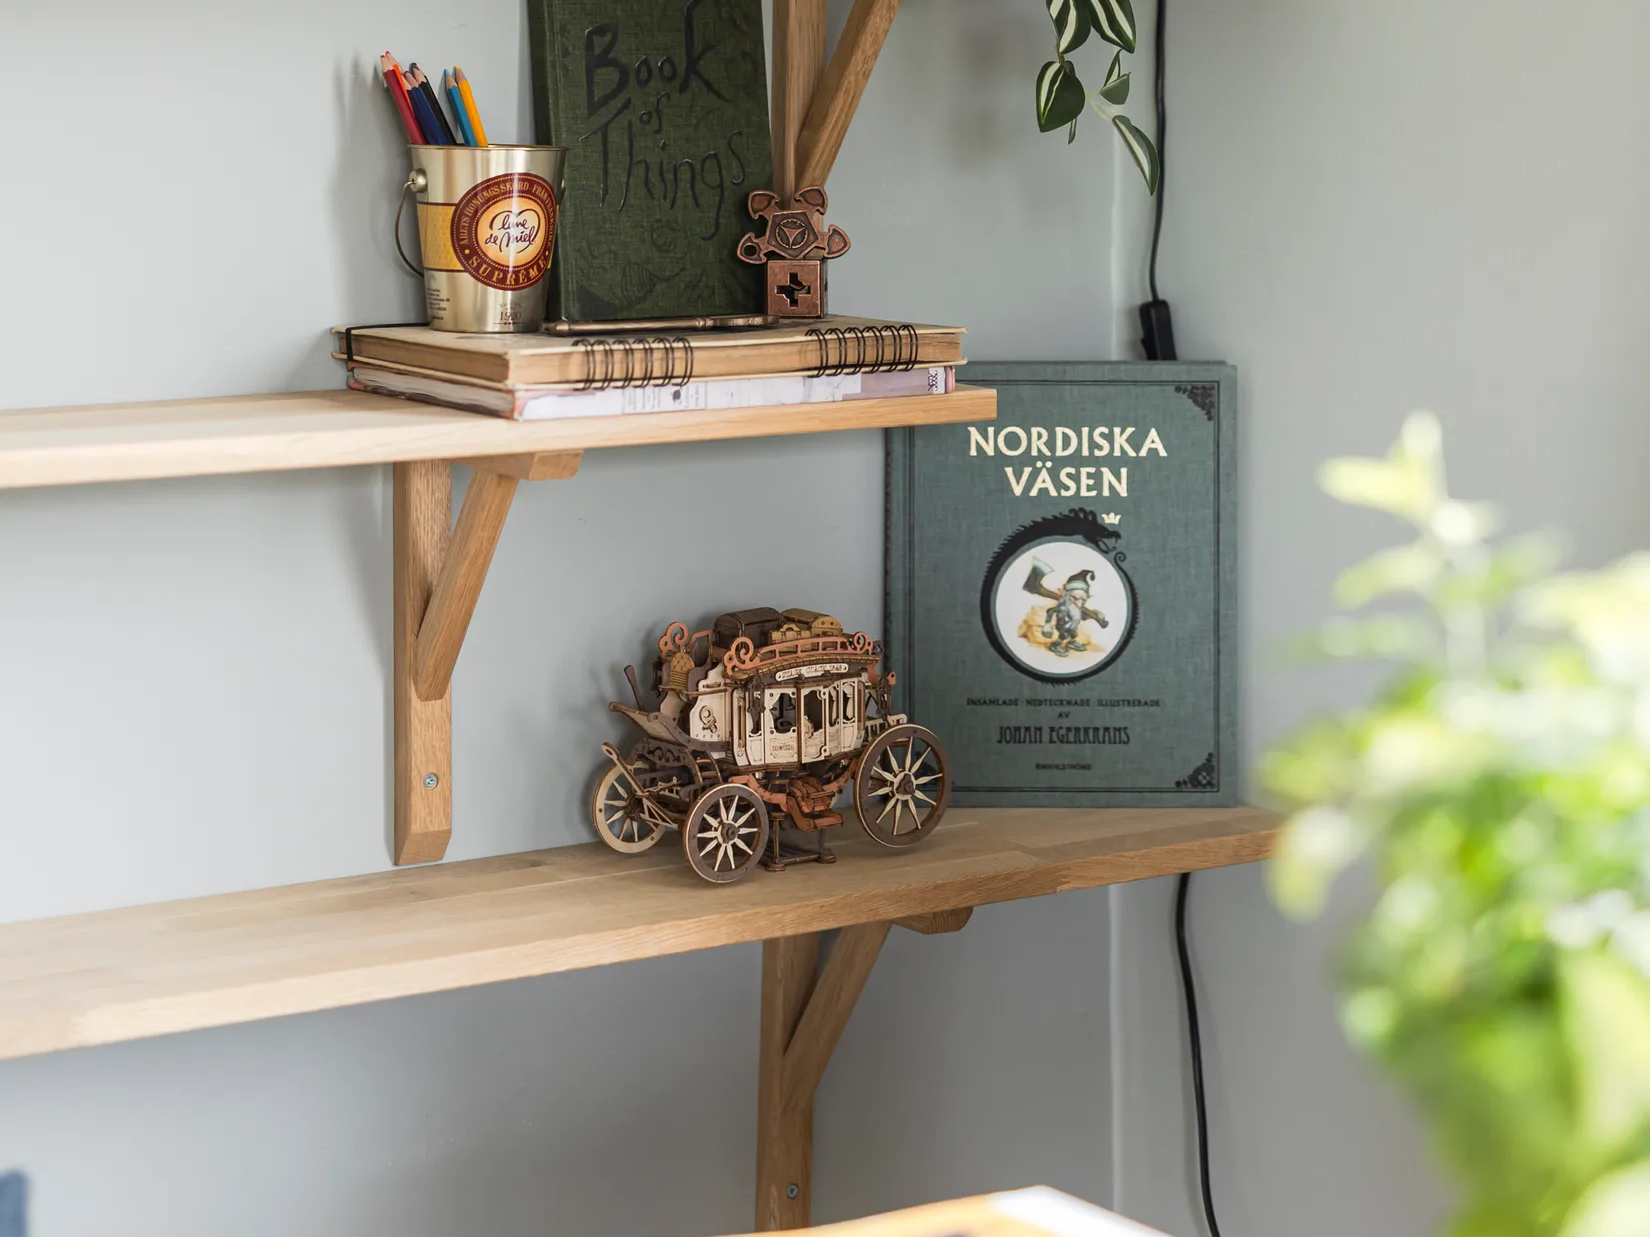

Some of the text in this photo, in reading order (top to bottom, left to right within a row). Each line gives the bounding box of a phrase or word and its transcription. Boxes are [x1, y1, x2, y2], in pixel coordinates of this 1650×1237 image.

[639, 91, 671, 134] of
[578, 95, 747, 241] Things
[485, 233, 498, 246] de
[469, 255, 546, 285] SUPRÊME
[967, 426, 1168, 457] NORDISKA
[1004, 461, 1128, 497] VÄSEN
[966, 698, 1161, 708] ENSAMLADE NEDTECKNADE ILLUSTRERADE
[996, 726, 1131, 745] JOHAN EGERKRANS
